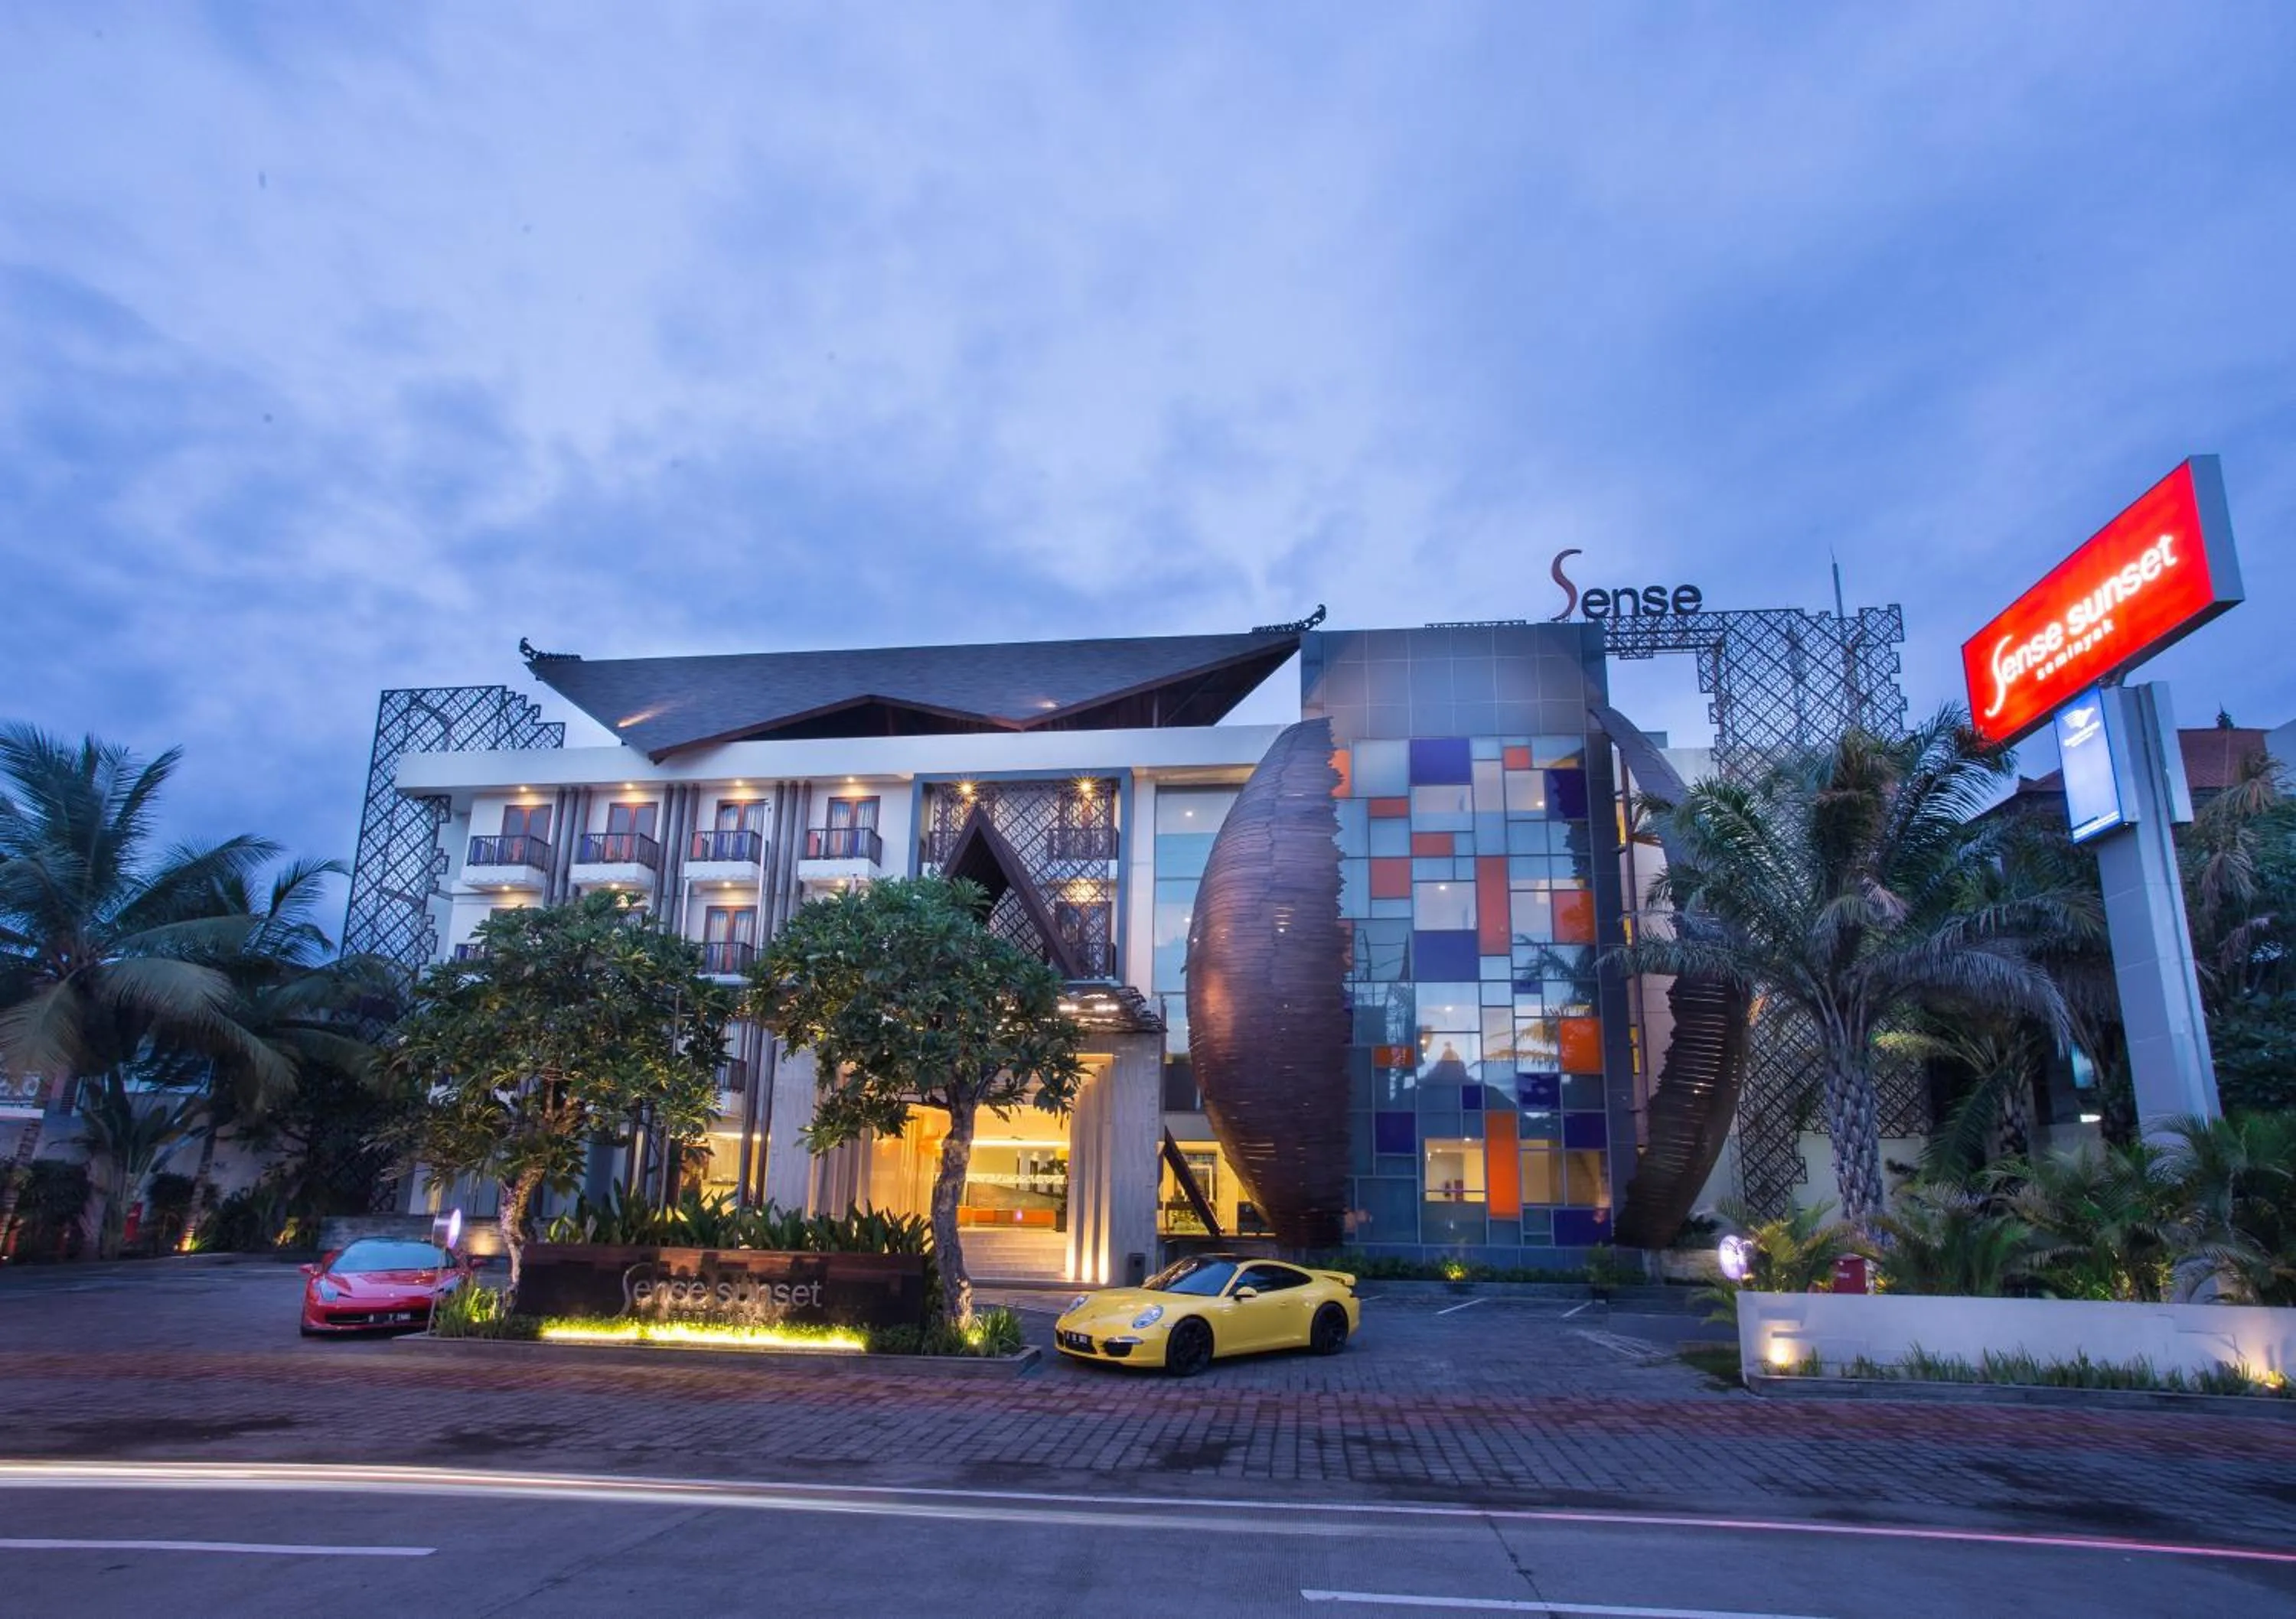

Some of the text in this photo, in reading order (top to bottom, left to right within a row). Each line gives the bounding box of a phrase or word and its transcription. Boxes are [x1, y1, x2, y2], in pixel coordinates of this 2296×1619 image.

[1551, 549, 1703, 621] Sense
[1985, 534, 2177, 718] Sense sunset
[2036, 619, 2114, 681] seminyak
[612, 1262, 823, 1321] Sense sunset
